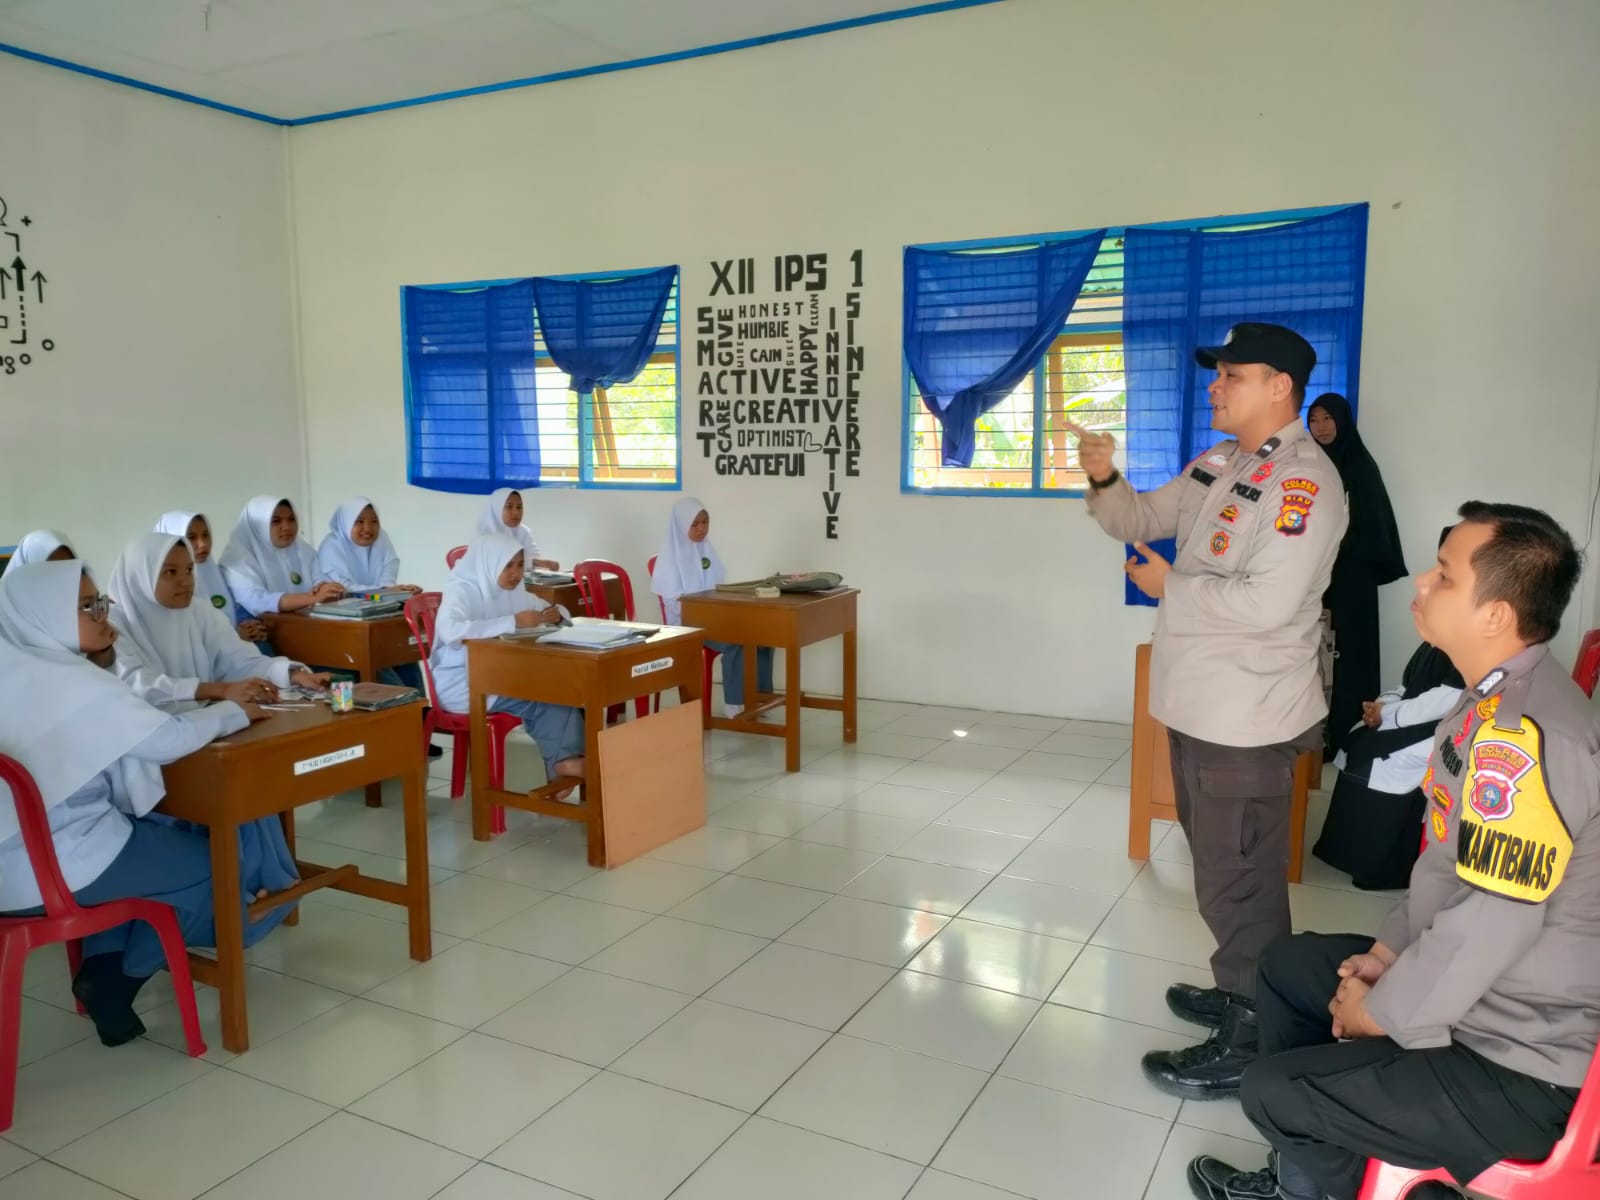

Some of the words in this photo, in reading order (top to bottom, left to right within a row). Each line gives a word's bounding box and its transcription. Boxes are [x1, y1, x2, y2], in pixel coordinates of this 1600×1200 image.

[709, 258, 755, 296] XII
[775, 253, 827, 292] IPS
[850, 249, 863, 288] 1
[738, 301, 804, 319] HONEST
[810, 293, 819, 327] CLEAN
[718, 308, 734, 367] GIVE
[799, 324, 818, 395] HAPPY
[698, 368, 796, 395] ACTIVE
[716, 400, 732, 453] CARE
[737, 429, 805, 447] OPTIMIST
[1285, 495, 1312, 505] RIAU
